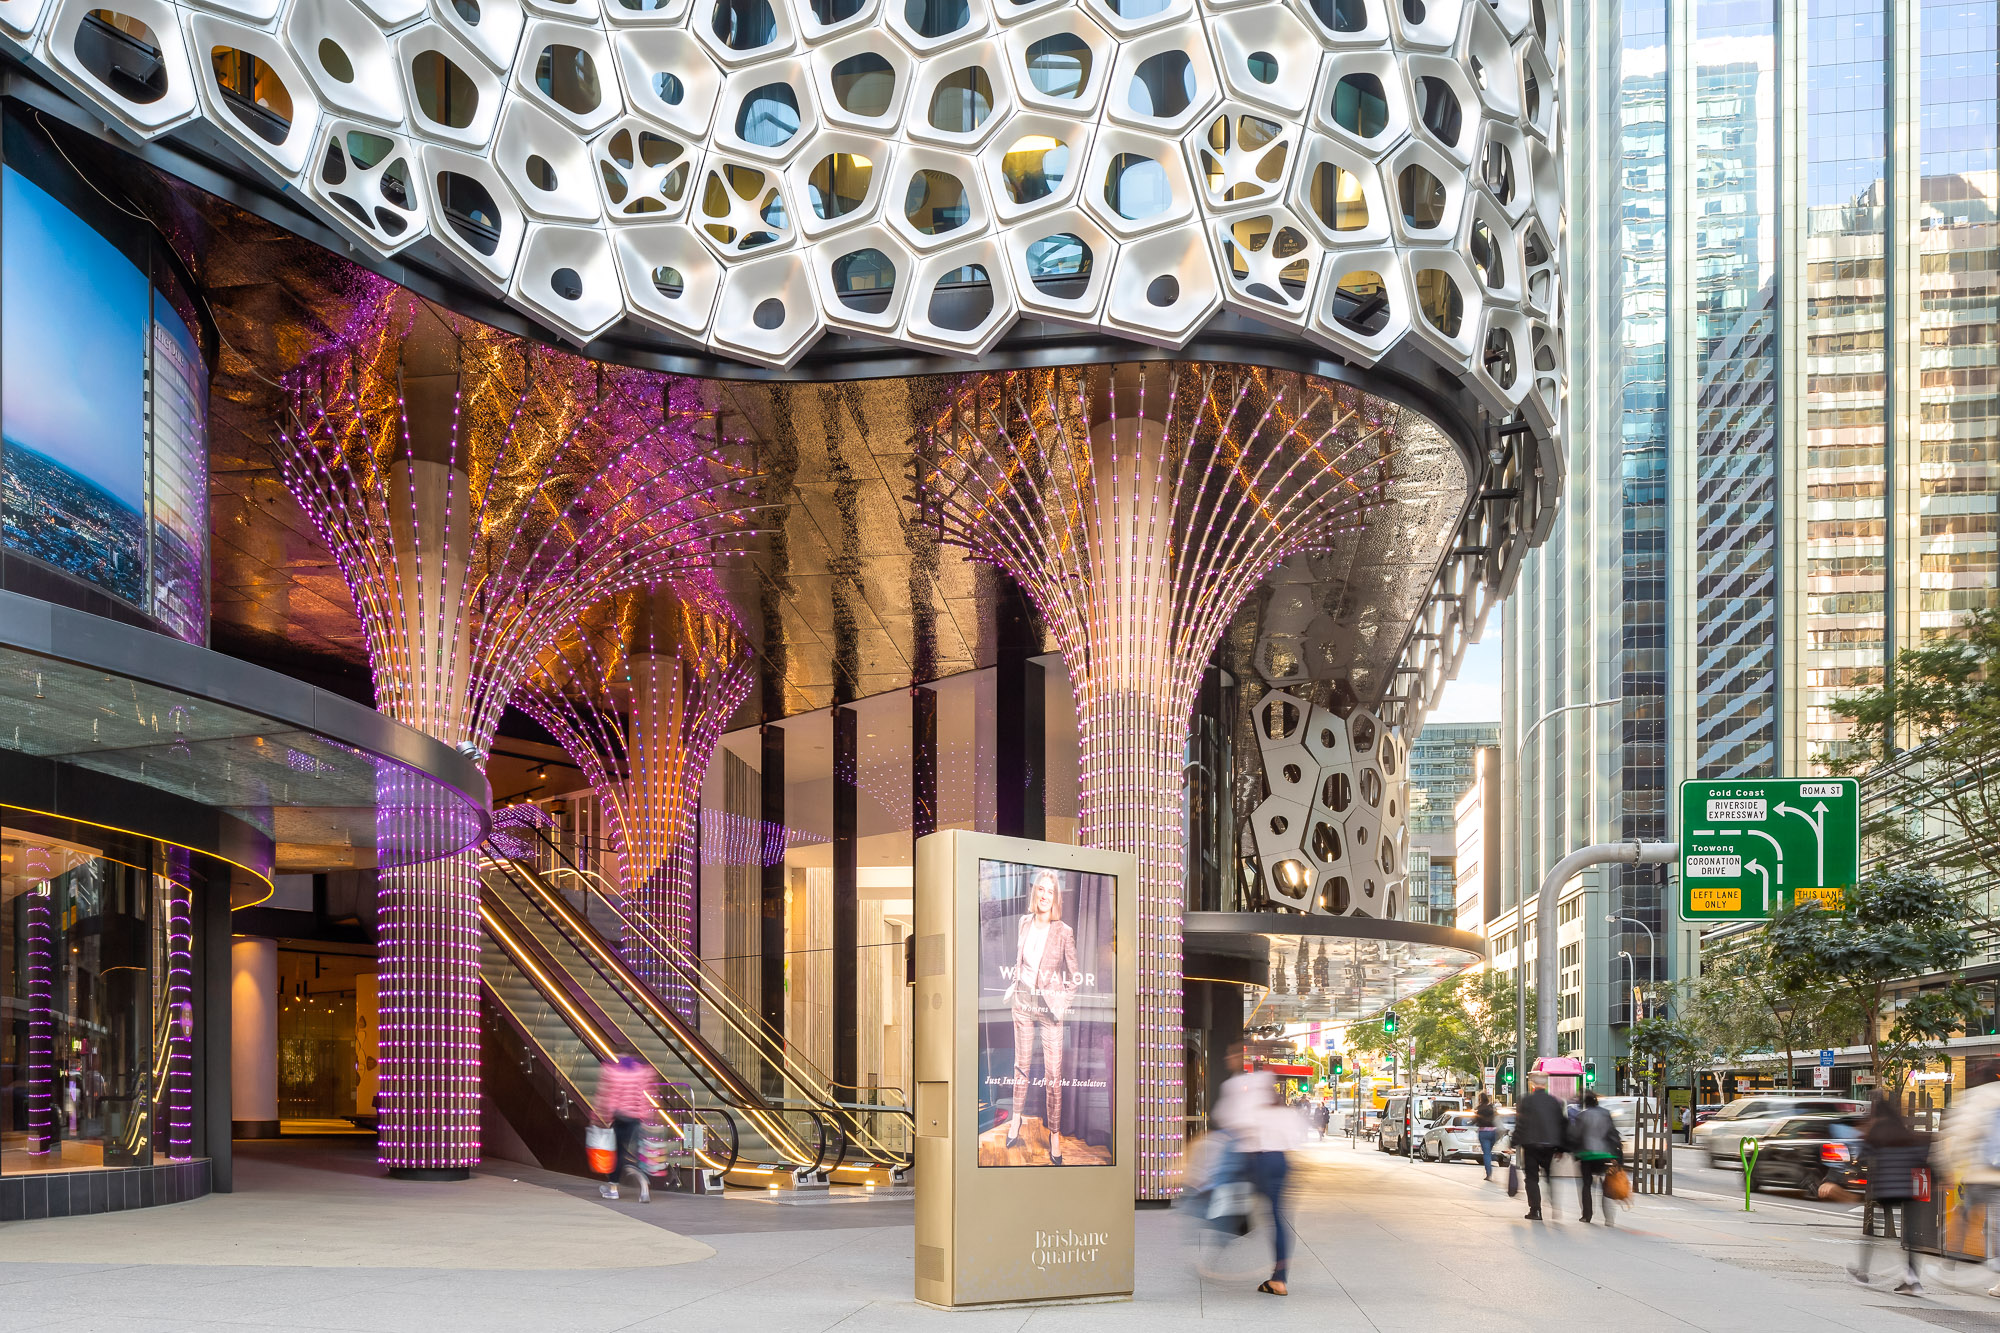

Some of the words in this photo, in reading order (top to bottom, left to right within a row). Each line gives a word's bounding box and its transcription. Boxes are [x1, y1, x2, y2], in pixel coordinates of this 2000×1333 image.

[1709, 789, 1731, 797] Gold
[1735, 789, 1765, 797] Coast
[1802, 787, 1826, 795] ROMA
[1830, 786, 1841, 795] ST
[1715, 801, 1758, 809] RIVERSIDE
[1708, 811, 1764, 819] EXPRESSWAY
[1691, 844, 1734, 854] Toowong
[1687, 857, 1740, 866] CORONATION
[1701, 867, 1726, 875] DRIVE
[1693, 891, 1713, 899] LEFT
[1716, 891, 1739, 899] LANE
[1797, 890, 1817, 899] THIS
[1704, 900, 1727, 909] ONLY
[1039, 969, 1095, 987] VALOR
[1030, 988, 1067, 998] BESPOK
[985, 1076, 1000, 1085] Just
[1003, 1076, 1025, 1086] Inside
[1032, 1078, 1047, 1088] Left
[1049, 1078, 1056, 1087] of
[1059, 1079, 1070, 1087] the
[1071, 1079, 1107, 1088] Escalators
[1036, 1229, 1109, 1248] Brisbane
[1031, 1248, 1099, 1272] Quarter
